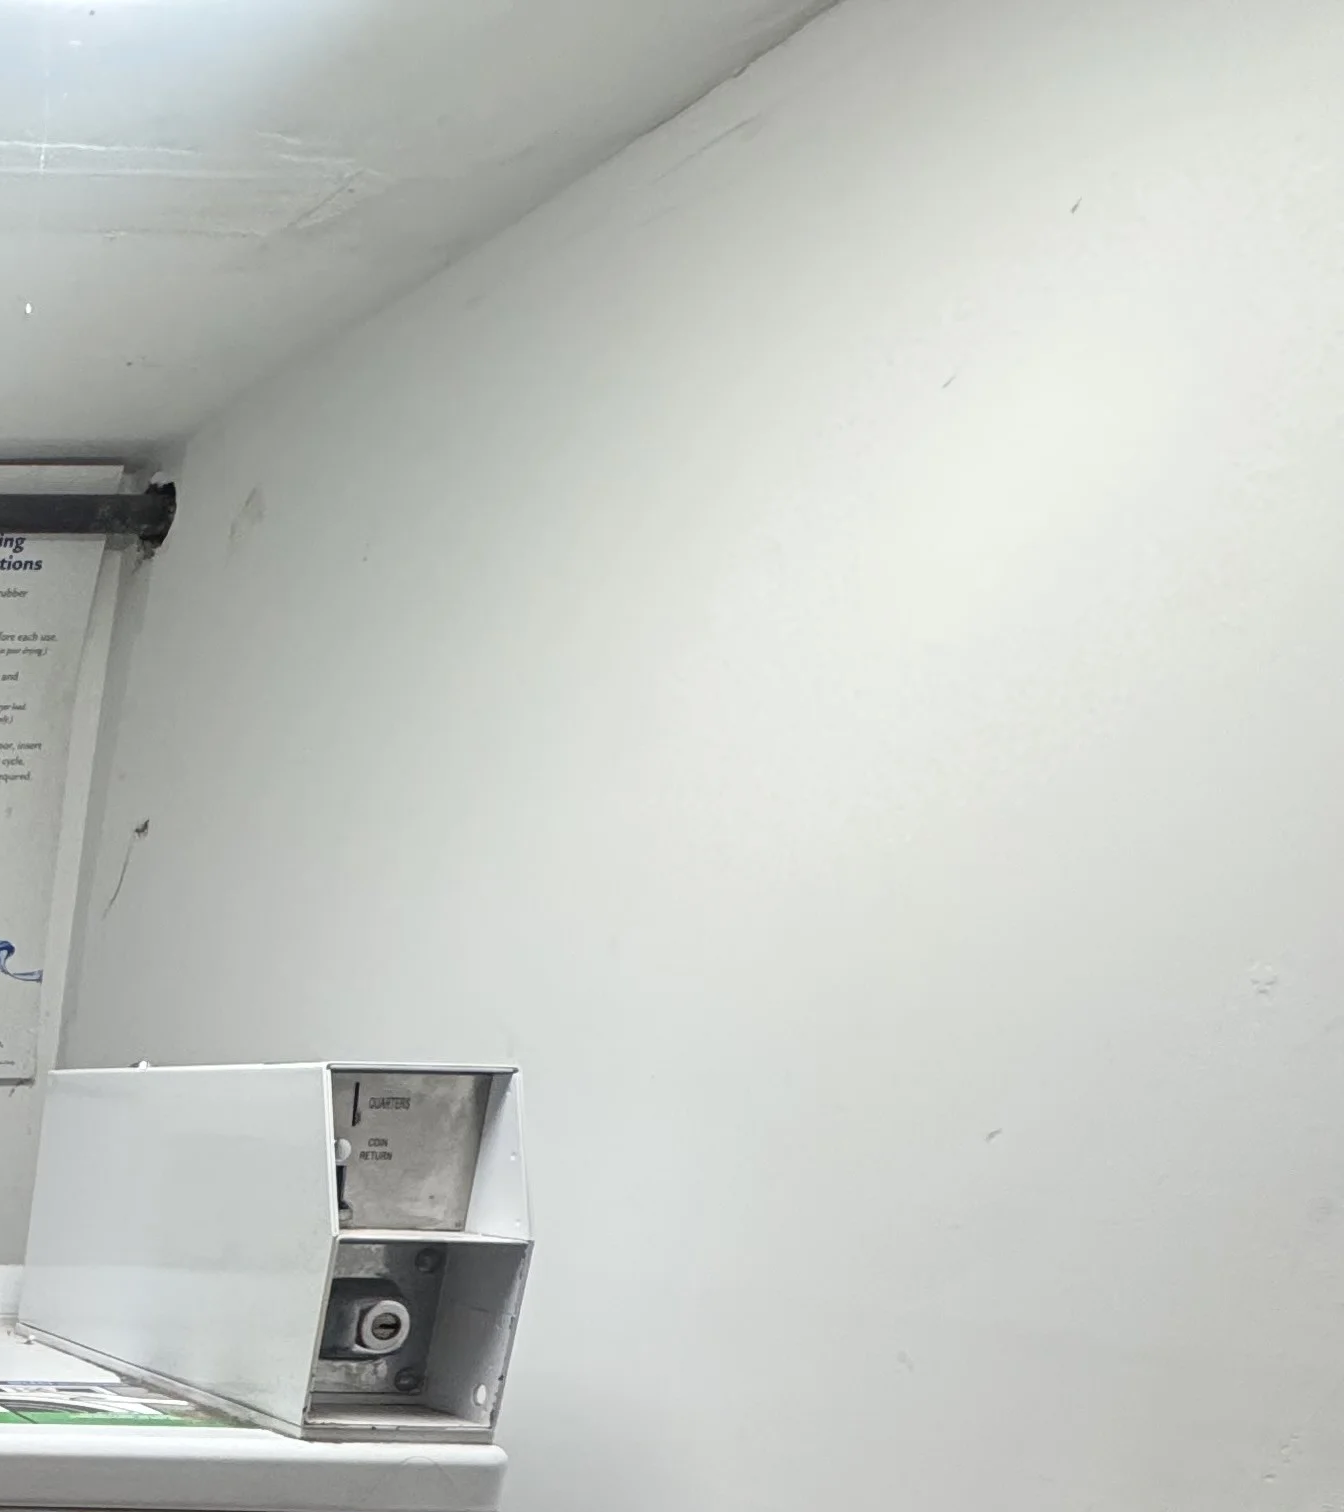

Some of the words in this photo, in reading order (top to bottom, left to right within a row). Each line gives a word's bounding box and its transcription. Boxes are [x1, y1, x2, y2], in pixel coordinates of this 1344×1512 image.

[369, 1097, 411, 1110] QUARTERS
[368, 1138, 388, 1147] COIN
[359, 1151, 393, 1161] RETURN
